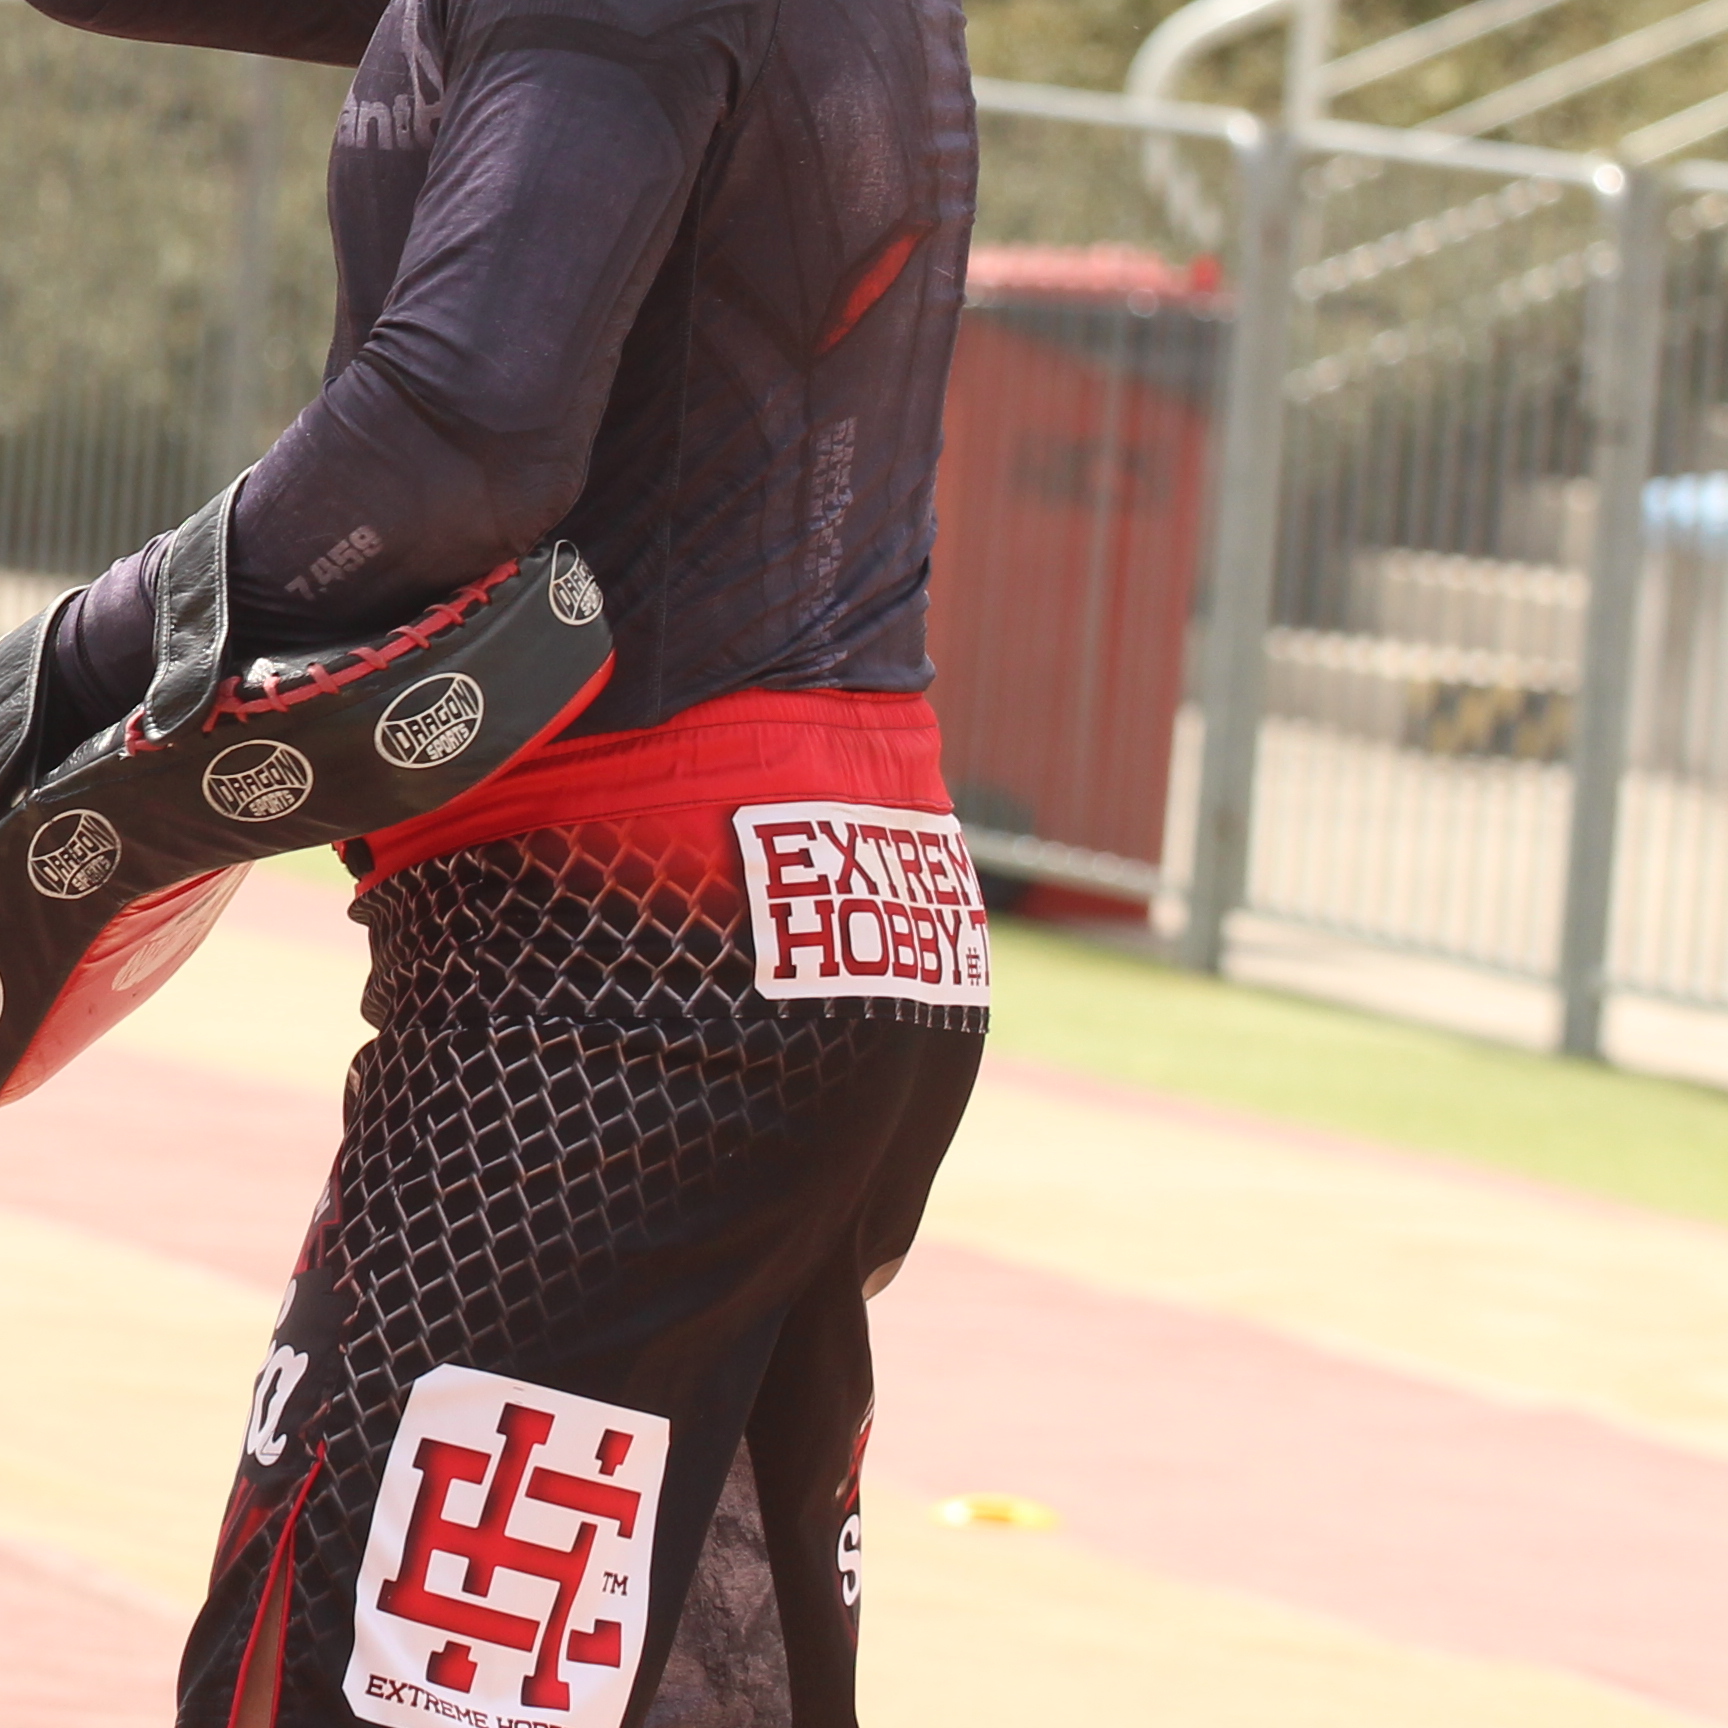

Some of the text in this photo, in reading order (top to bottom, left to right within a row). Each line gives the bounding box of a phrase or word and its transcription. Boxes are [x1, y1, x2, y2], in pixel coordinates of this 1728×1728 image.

[384, 679, 478, 762] DRAGON
[425, 722, 470, 761] SPORTS
[208, 749, 306, 813] DRAGON
[248, 789, 296, 817] SPORTS
[32, 815, 116, 893] DRAGON
[71, 854, 111, 892] SPORTS
[769, 898, 963, 986] HOBBY
[365, 1674, 488, 1727] EXTREME
